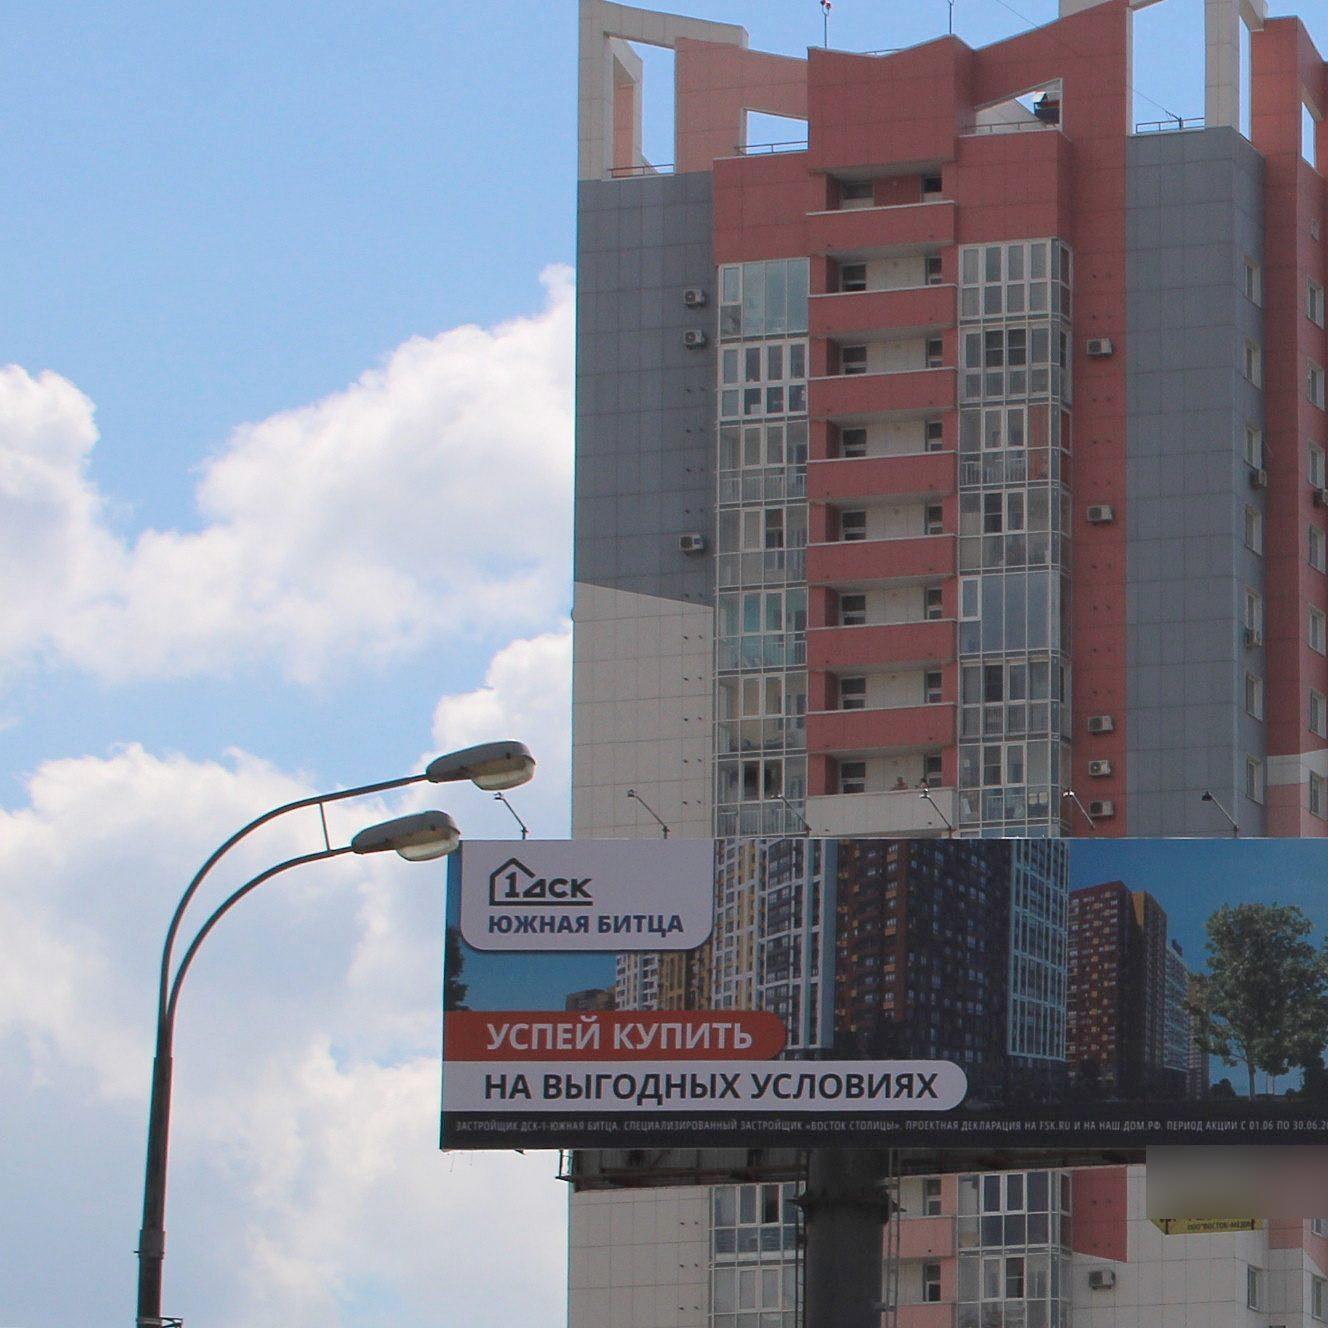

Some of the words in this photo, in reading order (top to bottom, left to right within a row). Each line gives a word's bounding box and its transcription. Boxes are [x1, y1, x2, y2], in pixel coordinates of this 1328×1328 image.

[488, 913, 589, 935] ЮЖНАЯ
[597, 913, 684, 938] БИТЦА
[486, 1014, 601, 1051] УСПЕЙ
[613, 1021, 754, 1050] КУПИТЬ
[484, 1073, 532, 1100] НА
[543, 1072, 740, 1106] ВЫГОДНЫХ
[750, 1072, 939, 1100] УСЛОВИЯХ
[456, 1118, 518, 1133] ЗАСТРОЙЩИК
[624, 1118, 737, 1132] СПЕЦИАЛИЗИРОВАННЫЙ
[740, 1118, 802, 1132] ЗАСТРОЙЩИК
[905, 1119, 958, 1131] ПРОЕКТНАЯ
[961, 1119, 1021, 1132] ДЕКЛАРАЦИЯ
[1024, 1119, 1037, 1131] НА
[1039, 1119, 1071, 1131] FSK.RU
[1083, 1119, 1096, 1131] НА
[1099, 1119, 1120, 1131] НАШ
[1167, 1120, 1202, 1132] ПЕРИОД
[1206, 1120, 1238, 1132] АКЦИИ
[1249, 1120, 1274, 1131] 01.06
[1277, 1120, 1290, 1131] ПО
